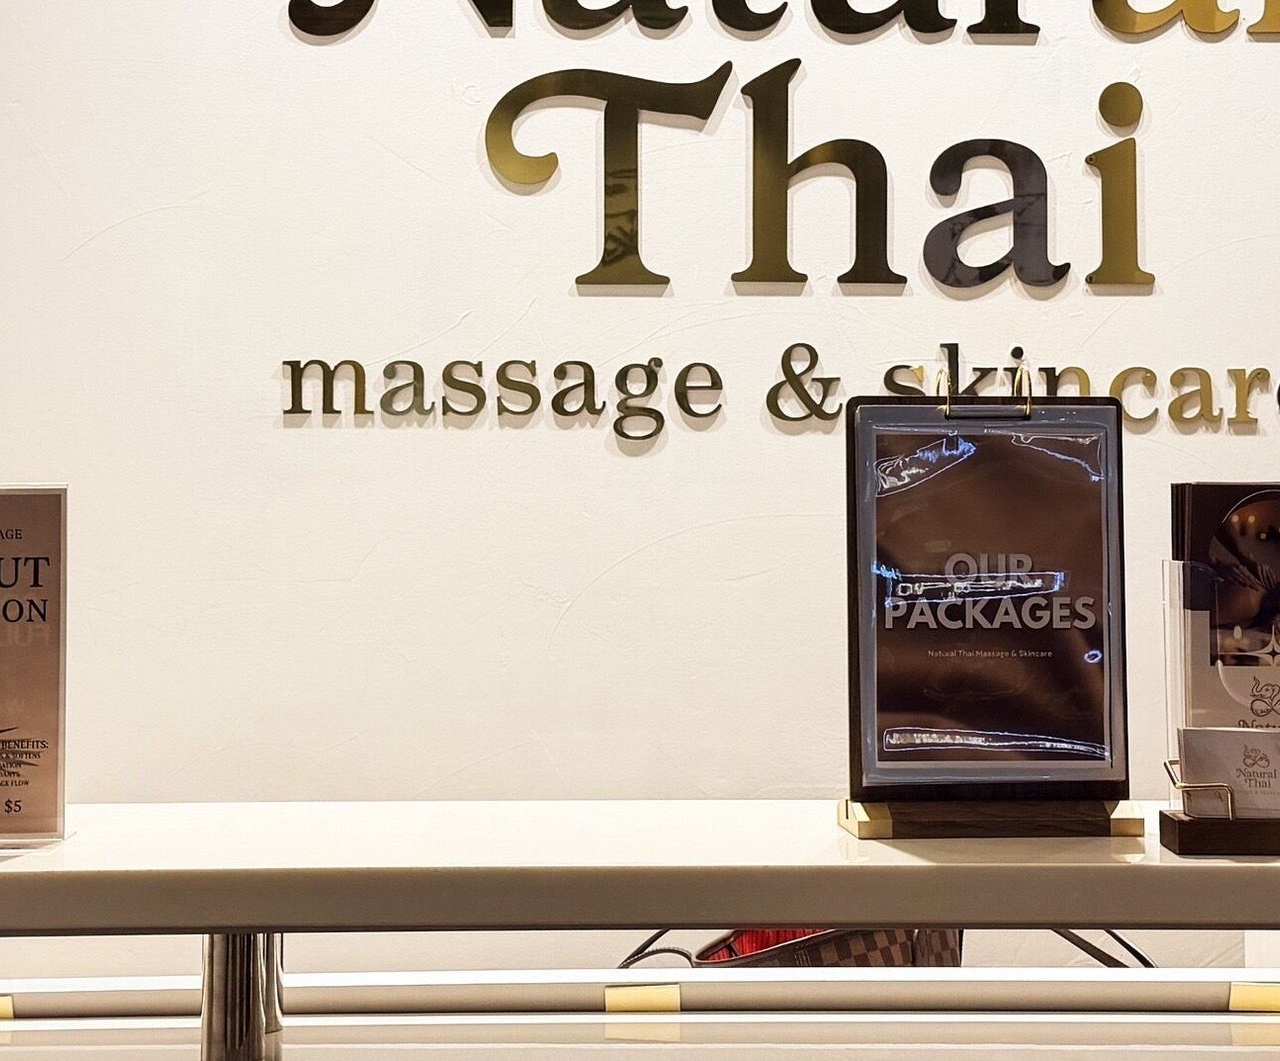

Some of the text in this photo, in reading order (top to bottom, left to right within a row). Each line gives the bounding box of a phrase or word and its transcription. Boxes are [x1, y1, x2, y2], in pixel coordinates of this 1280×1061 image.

[484, 57, 1156, 288] Thai
[281, 355, 724, 441] massage
[765, 341, 845, 422] &
[944, 553, 1034, 585] OUR
[884, 596, 1097, 630] PACKAGES
[927, 649, 957, 657] Natural
[958, 649, 975, 657] Thai
[976, 649, 1010, 659] Massage
[1019, 649, 1053, 657] Skincare
[1, 740, 49, 750] BENEFITS:
[1236, 768, 1277, 779] Natural
[1244, 777, 1271, 789] Thai
[4, 799, 22, 814] $5
